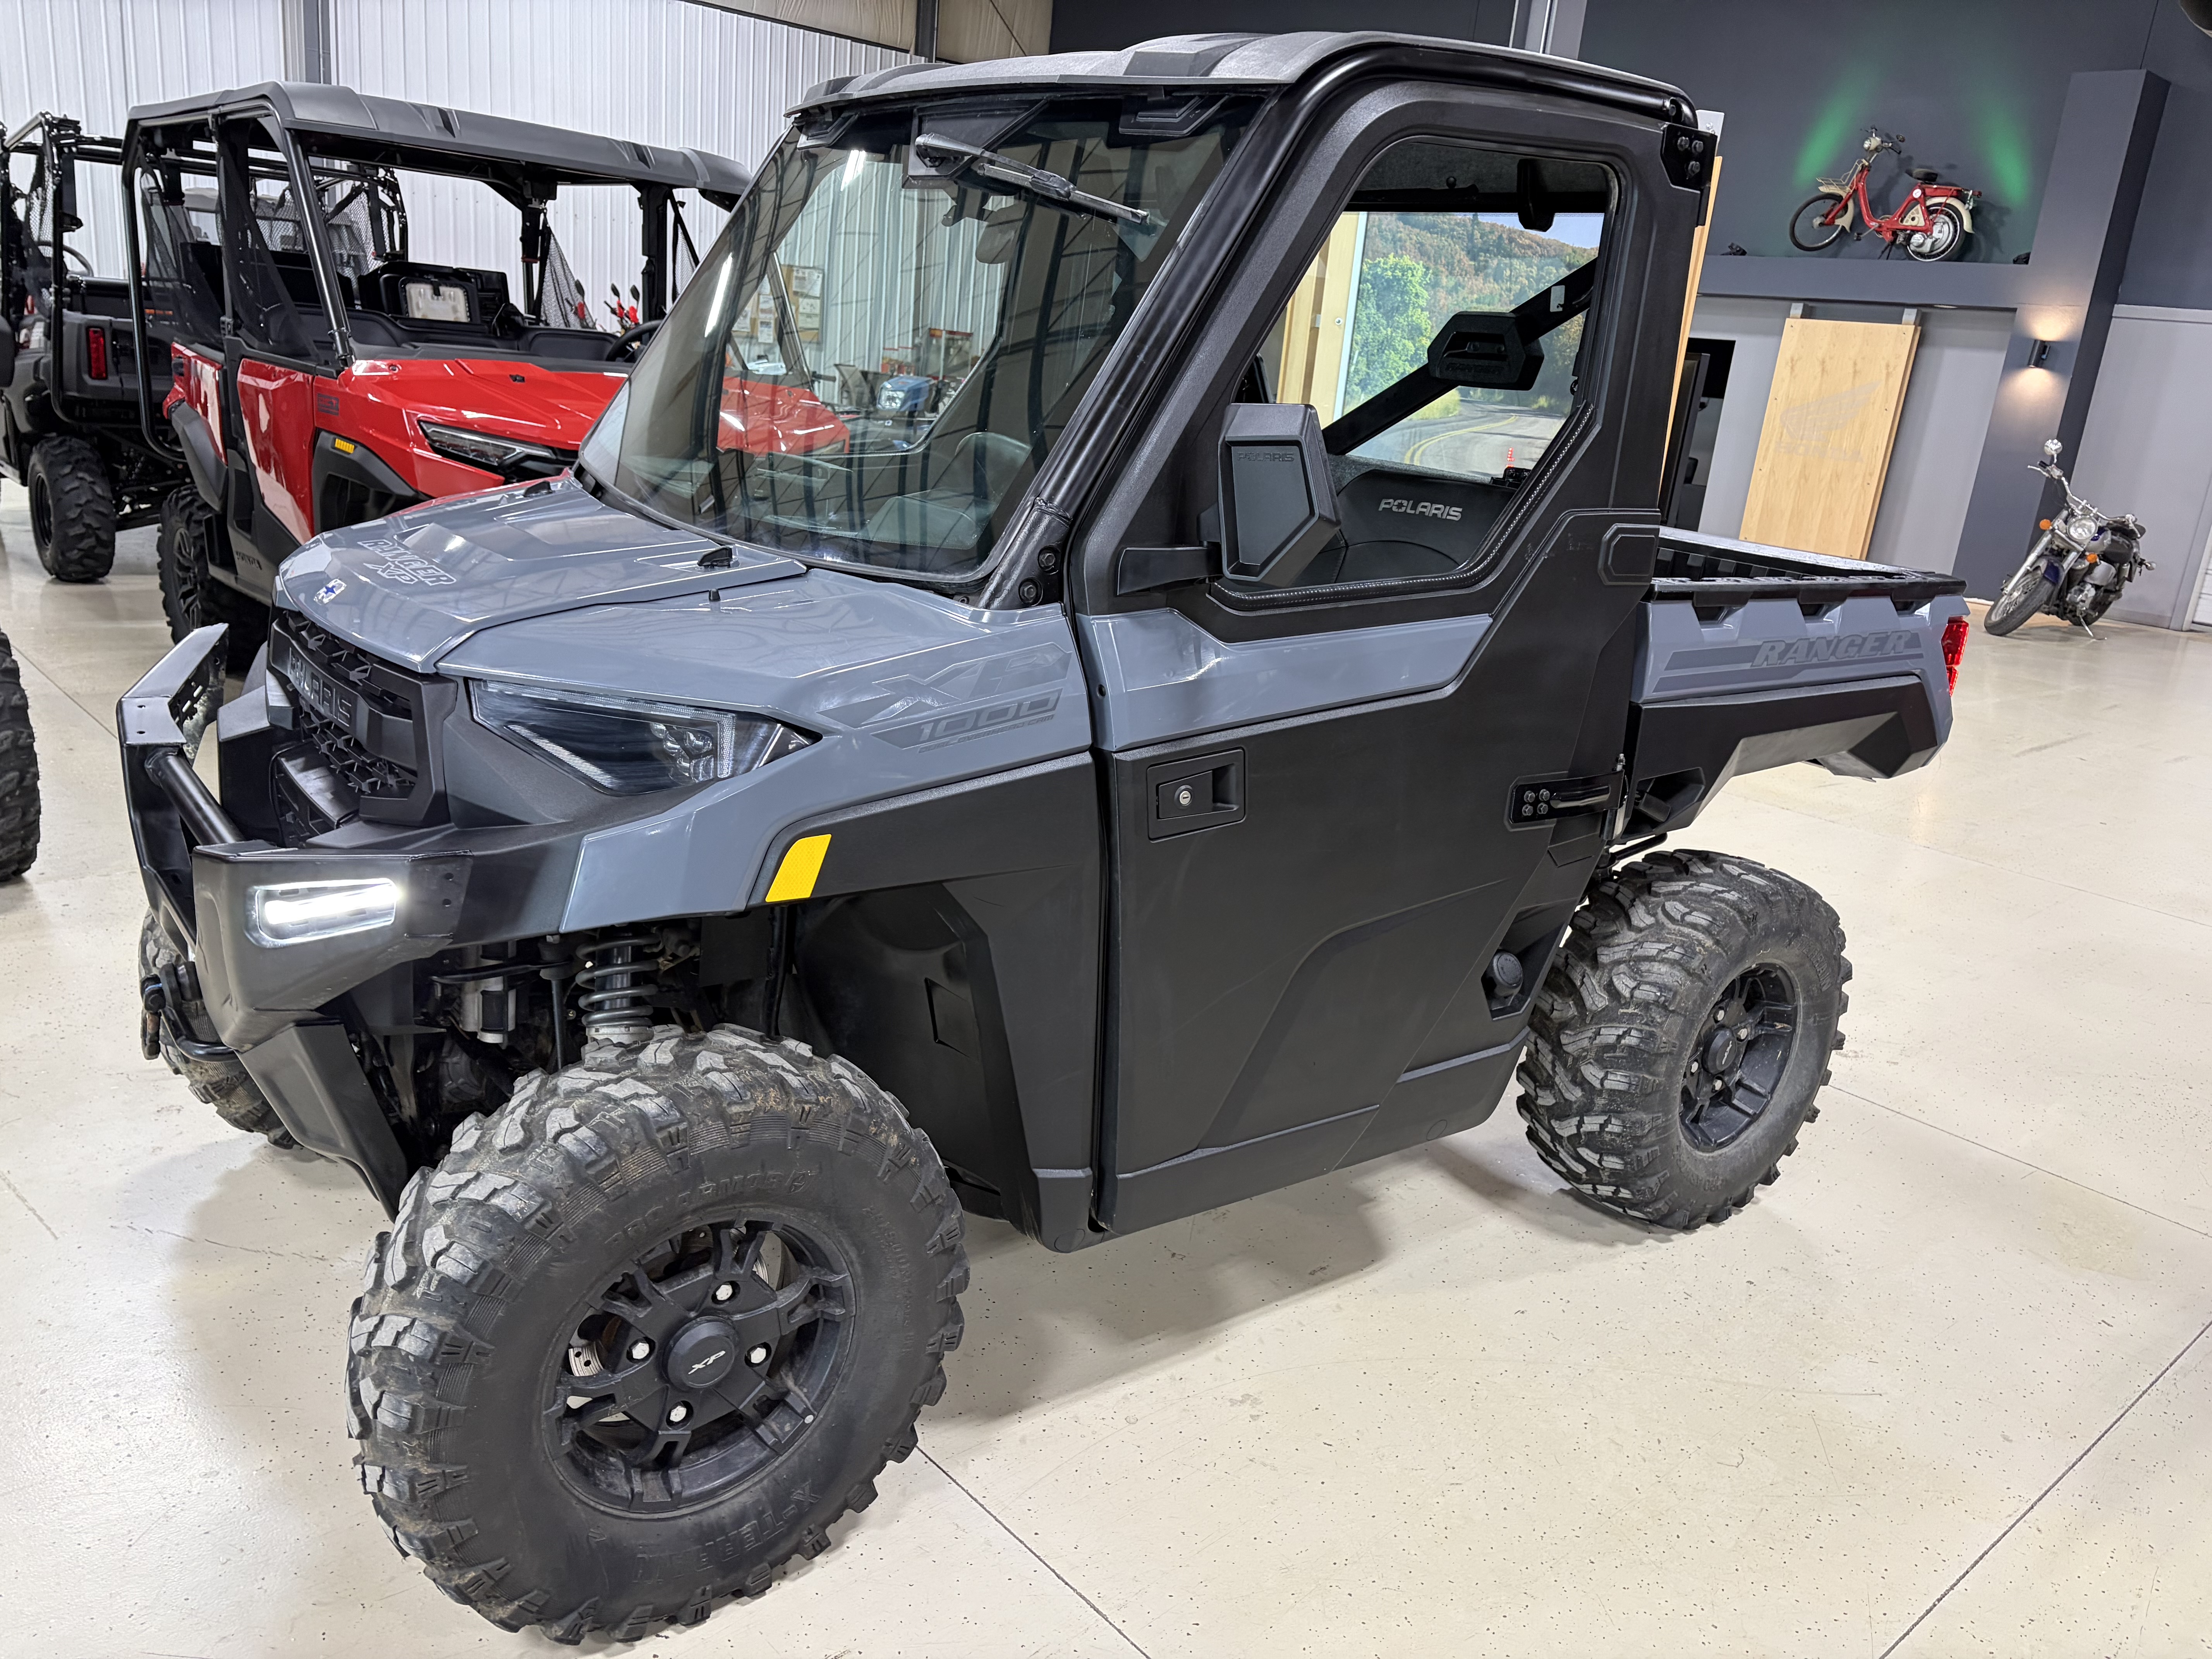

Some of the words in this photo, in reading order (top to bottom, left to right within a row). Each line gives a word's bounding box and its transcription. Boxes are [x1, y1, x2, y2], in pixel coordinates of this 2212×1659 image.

[1237, 452, 1295, 462] POLARIS
[1378, 498, 1463, 521] POLARIS
[357, 539, 456, 586] RANGER
[363, 562, 418, 584] XP
[1750, 630, 1911, 667] RANGER
[288, 647, 352, 727] POLARIS
[816, 642, 1073, 730] XP
[918, 741, 952, 753] DUAL
[958, 723, 1024, 743] OVERHEAD
[1027, 714, 1055, 725] CAM
[919, 689, 1060, 742] 1000
[1722, 1041, 1732, 1065] XP
[688, 1350, 726, 1374] XP
